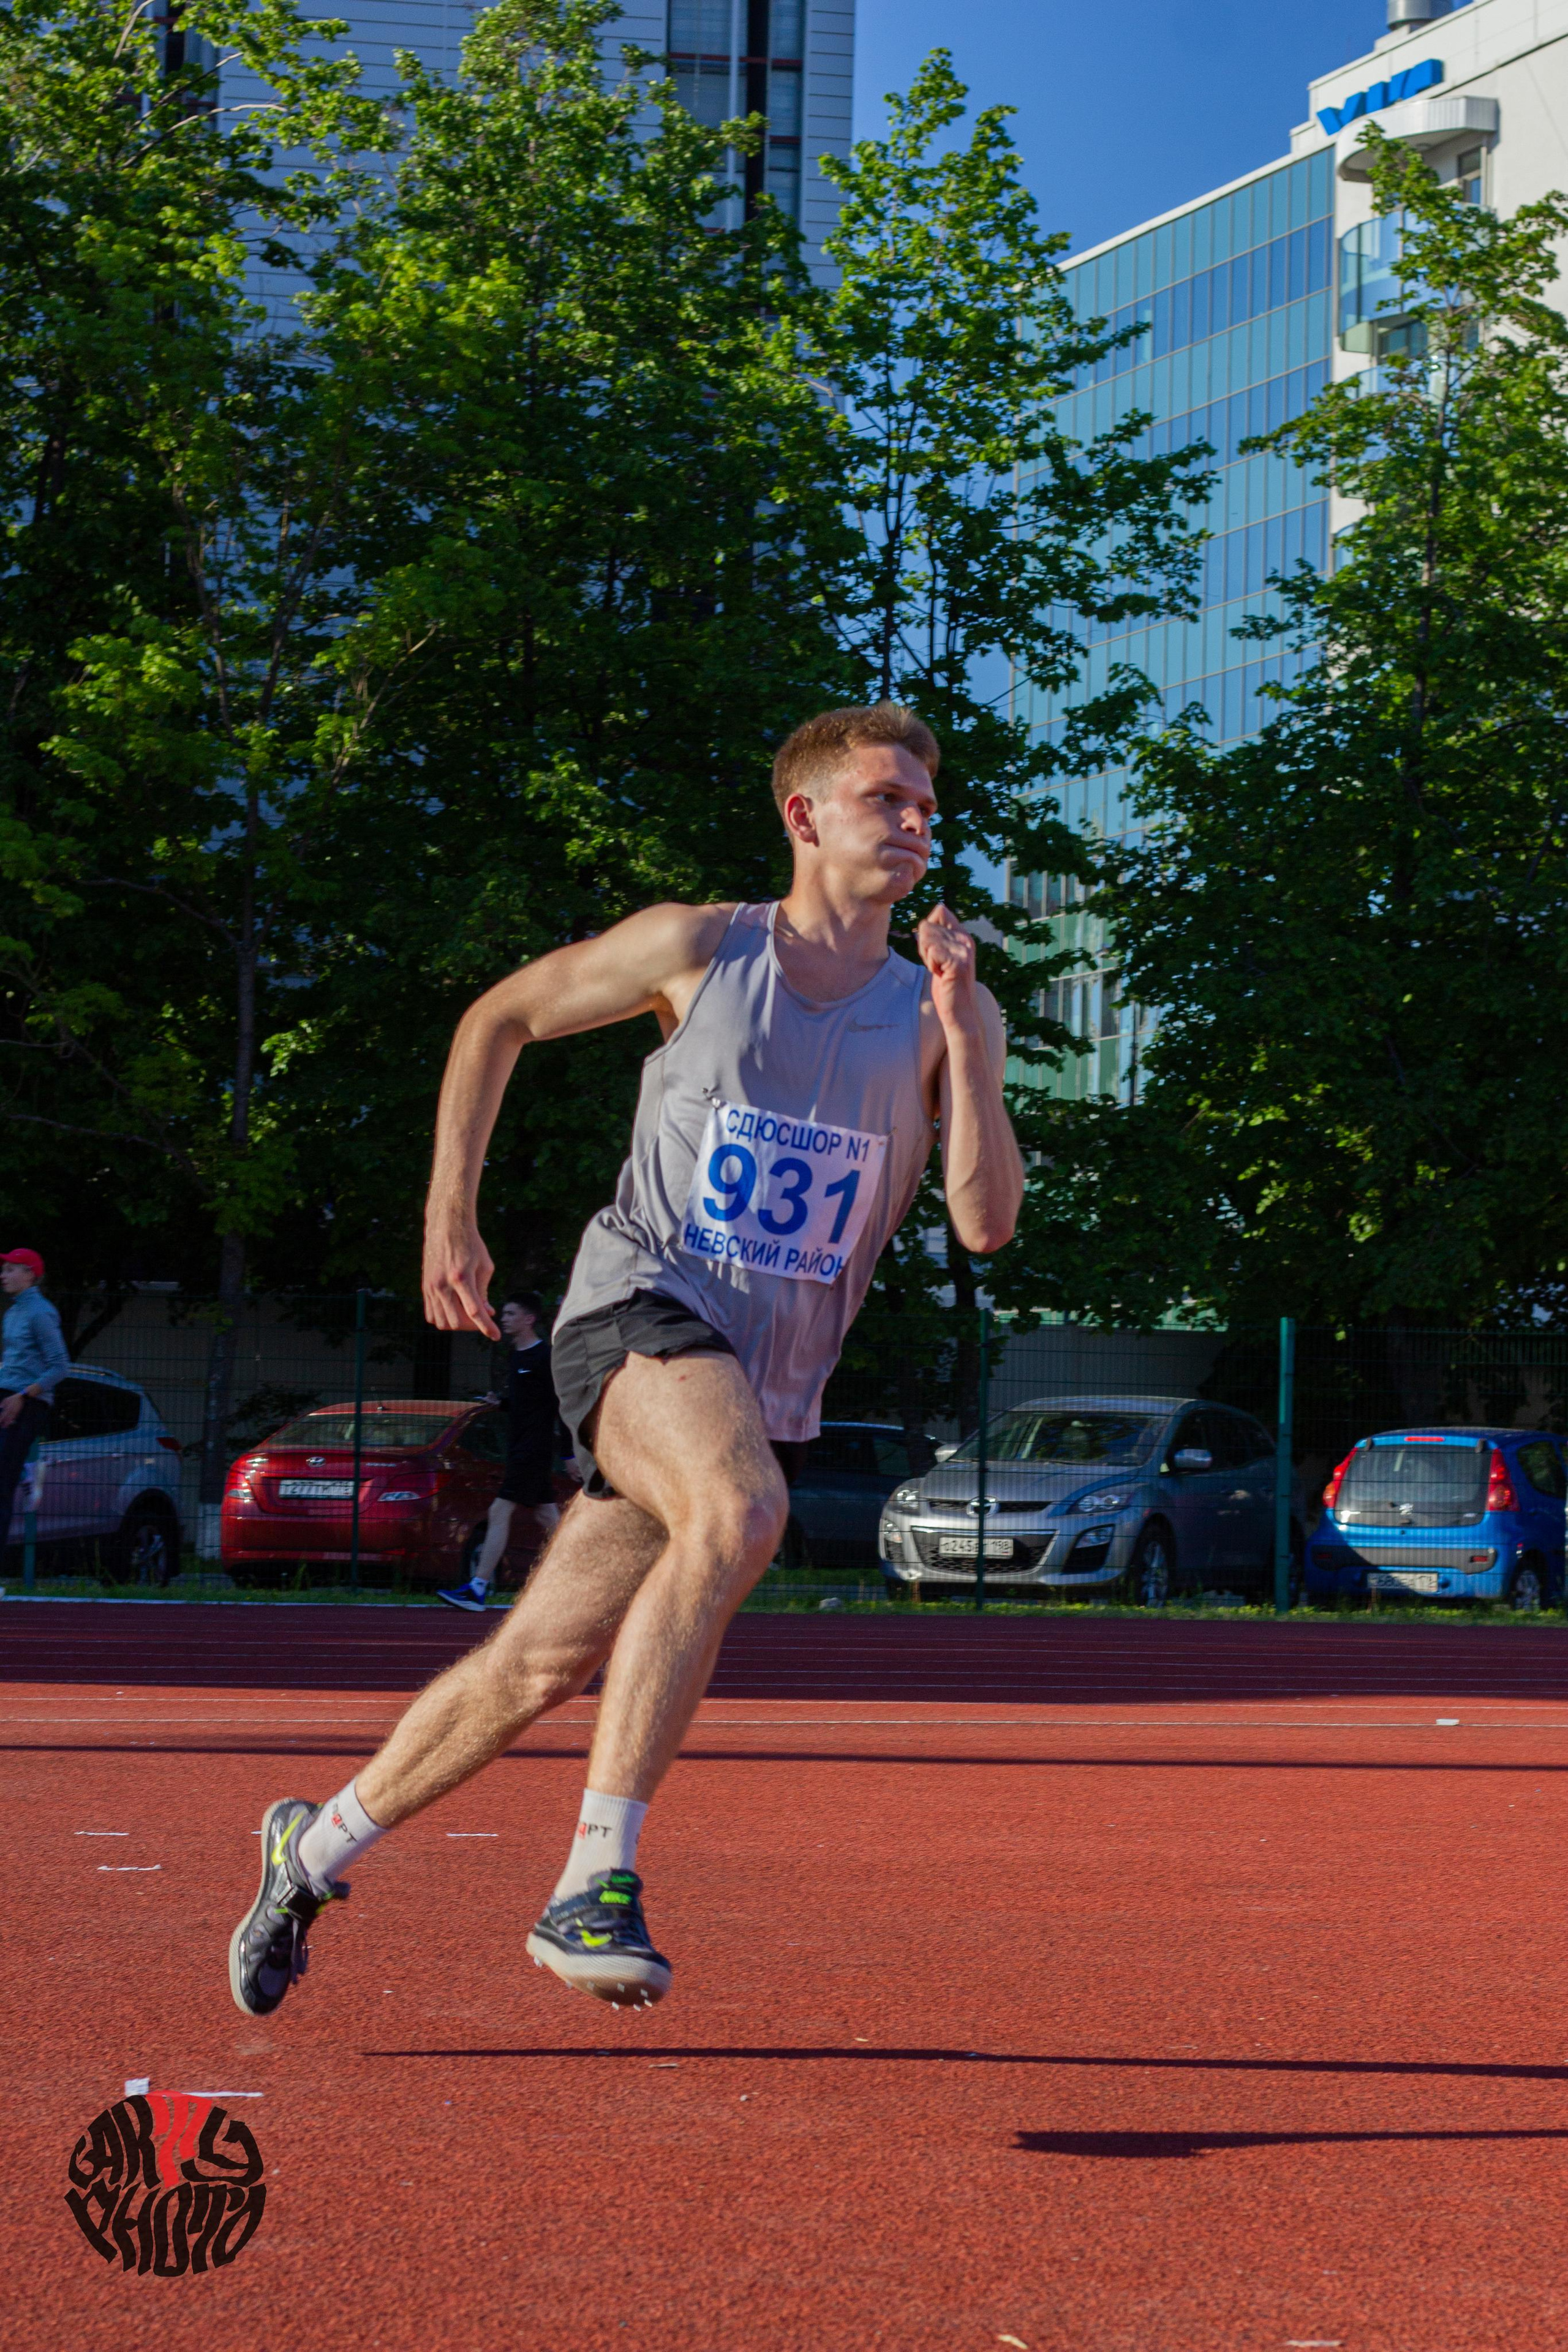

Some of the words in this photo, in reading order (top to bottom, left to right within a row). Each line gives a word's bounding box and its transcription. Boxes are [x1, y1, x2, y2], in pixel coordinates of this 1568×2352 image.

[726, 1109, 842, 1156] СДЮСШОР
[703, 1144, 861, 1245] 931
[684, 1223, 781, 1268] НЕВСКИЙ
